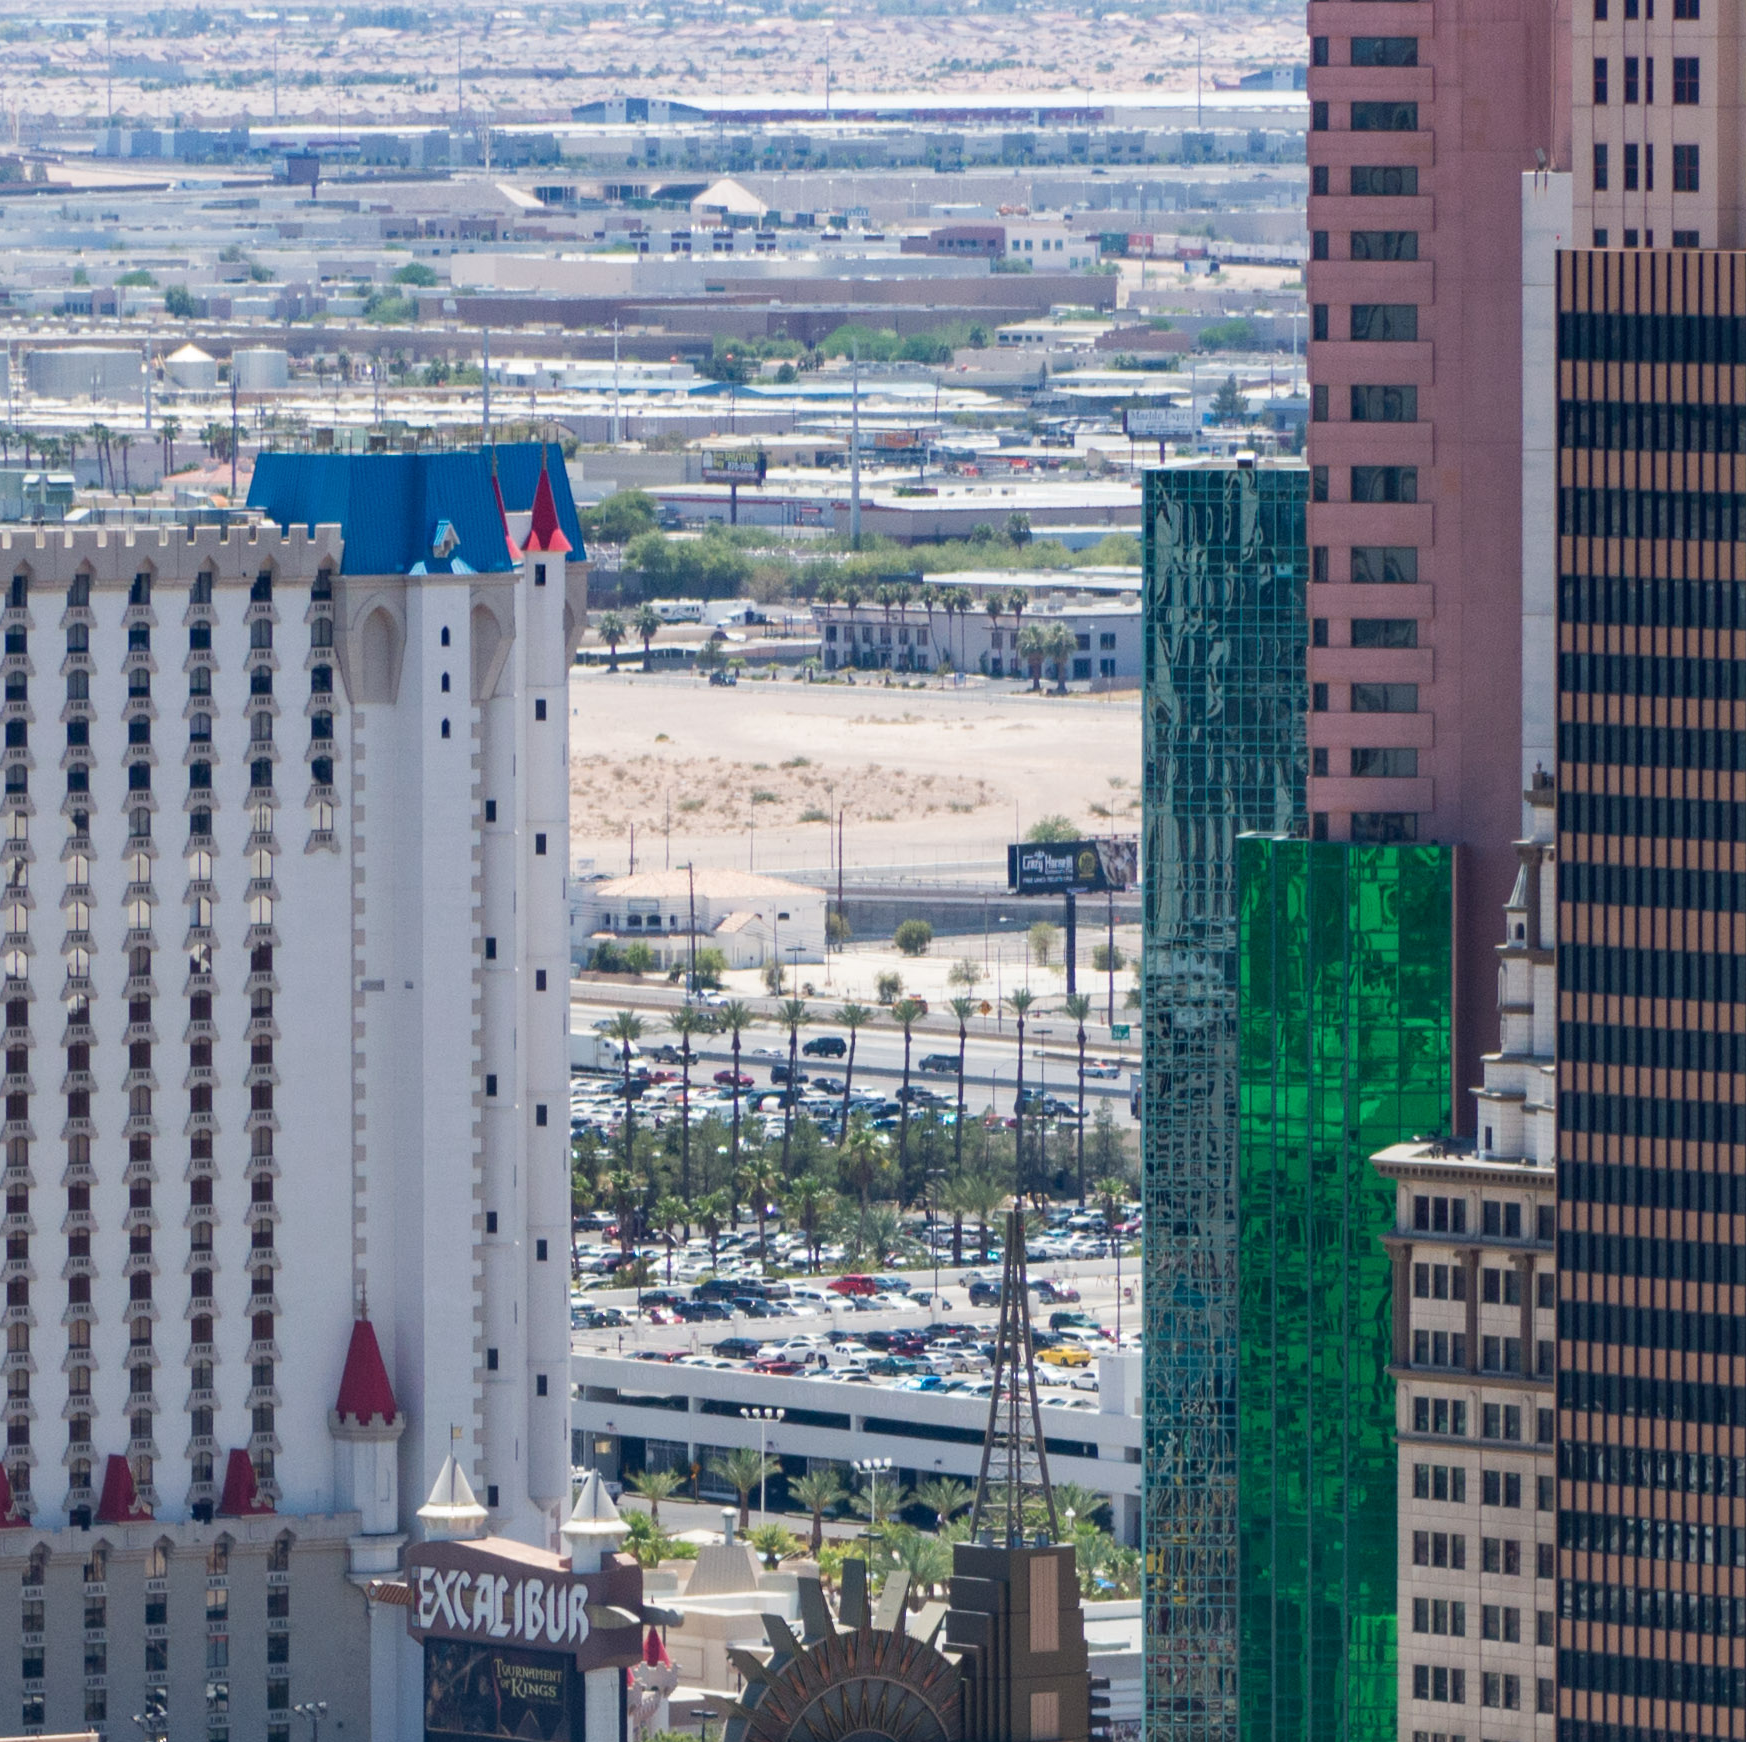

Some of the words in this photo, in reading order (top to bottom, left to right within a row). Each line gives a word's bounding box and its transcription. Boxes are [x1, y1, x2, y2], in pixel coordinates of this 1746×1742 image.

[418, 1566, 591, 1644] EXCALIBUR
[494, 1658, 562, 1683] TOURNAMENT
[511, 1678, 558, 1698] KINGS
